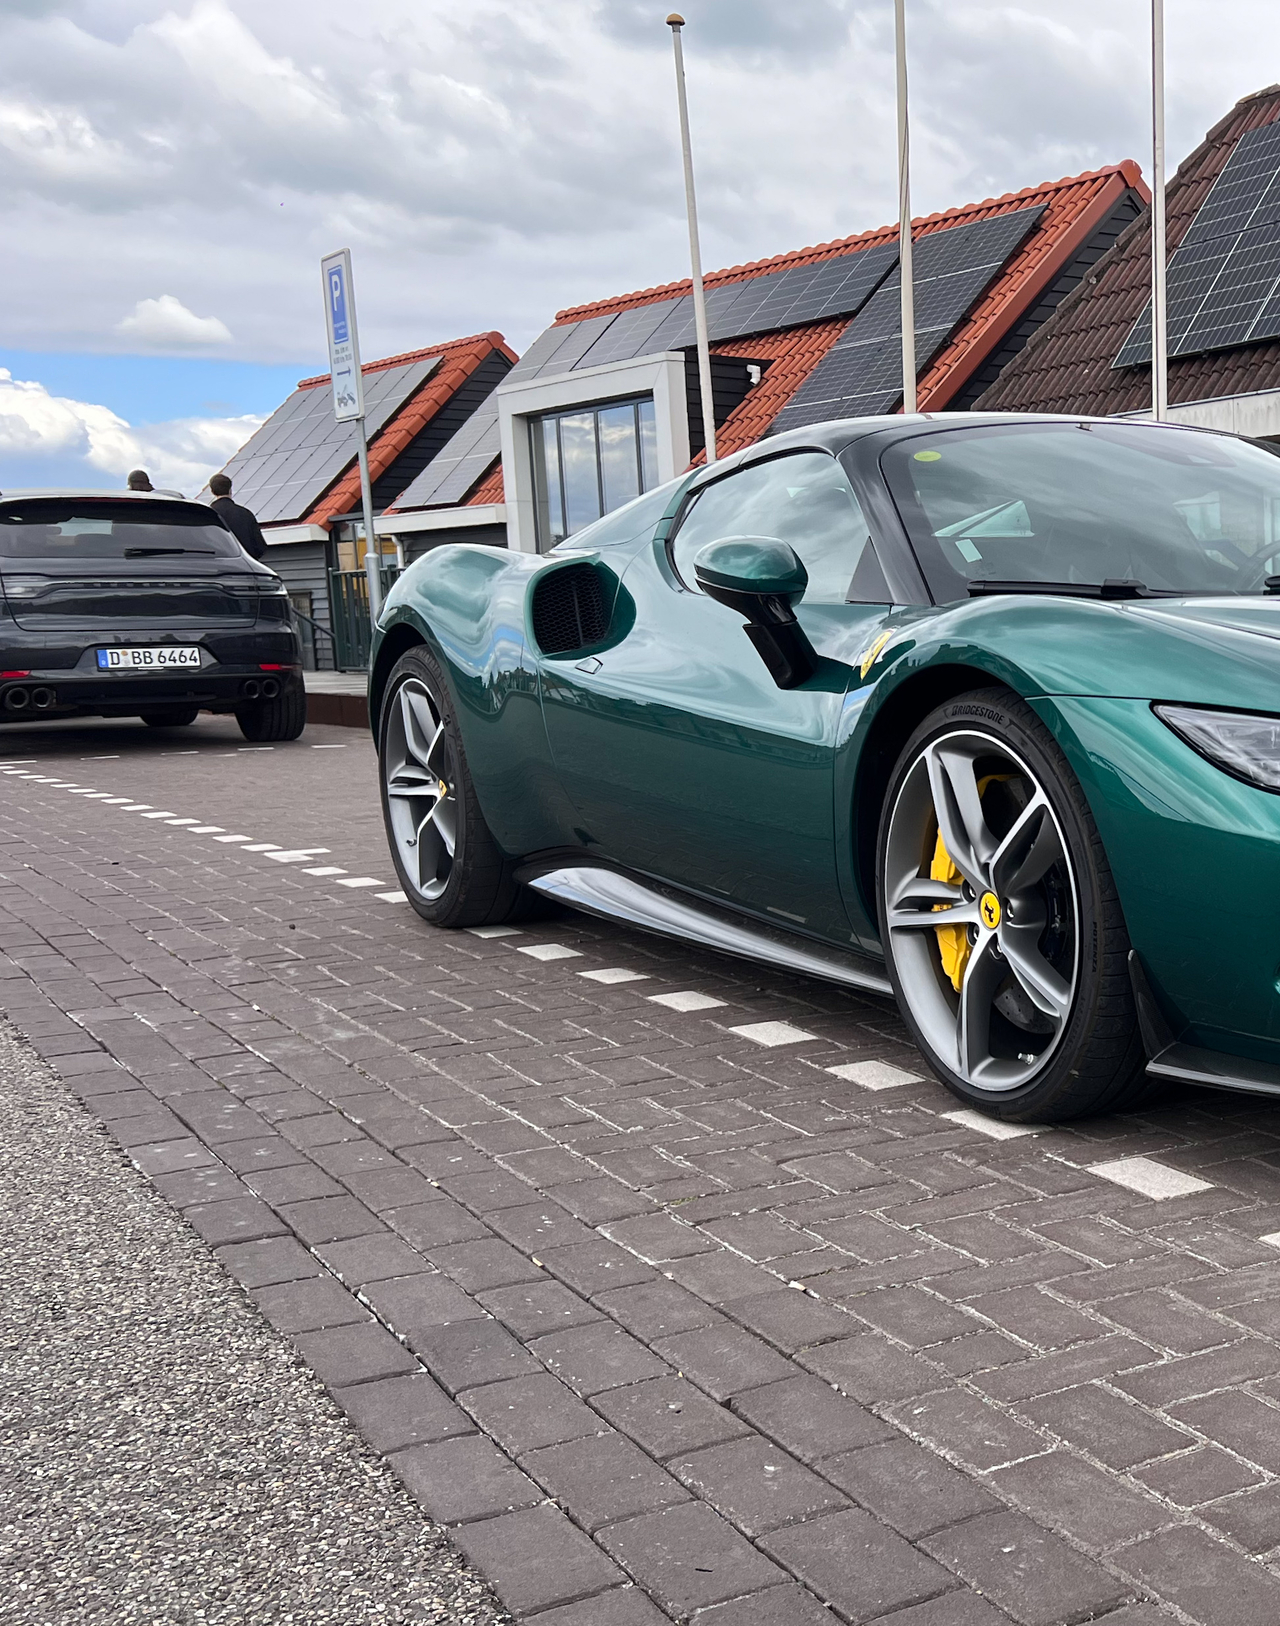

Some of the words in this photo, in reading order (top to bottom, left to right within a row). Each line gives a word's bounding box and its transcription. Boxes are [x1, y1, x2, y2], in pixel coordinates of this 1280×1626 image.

[332, 274, 341, 312] P
[109, 651, 120, 665] D
[131, 651, 153, 665] BB
[158, 650, 198, 664] 6464
[951, 704, 1005, 725] BRIDGESTONE
[1091, 921, 1099, 973] POTENZA
